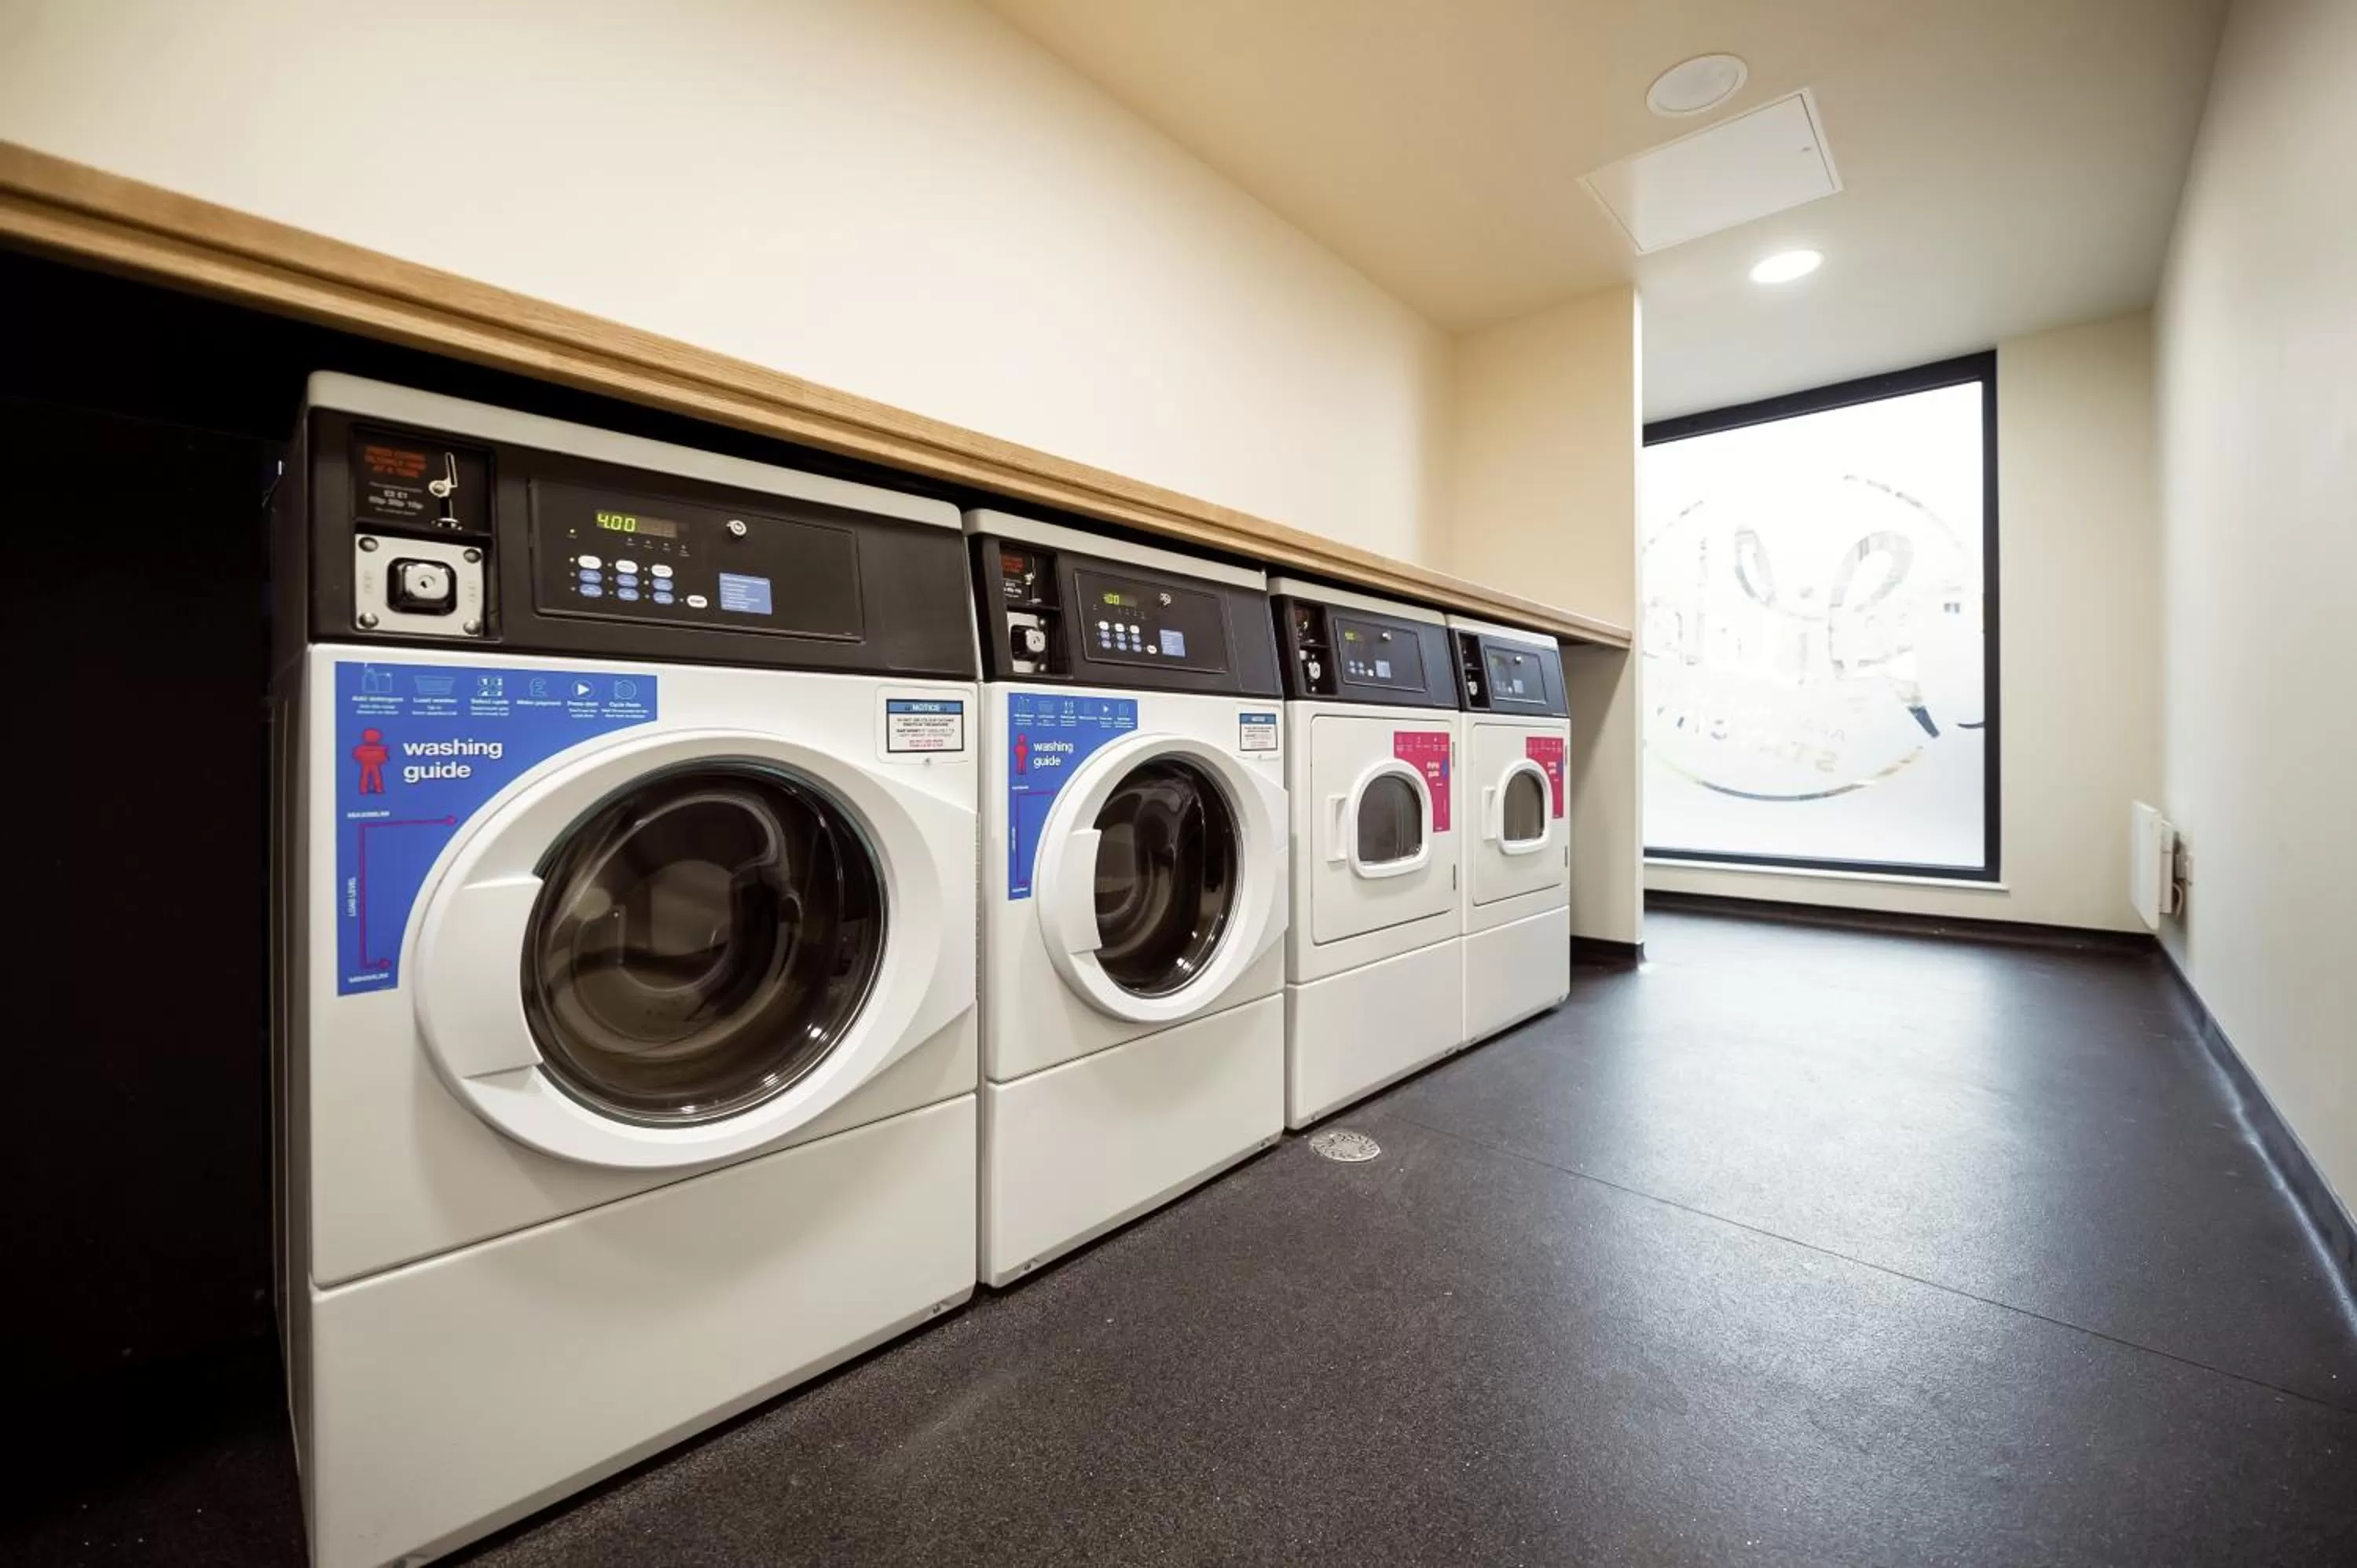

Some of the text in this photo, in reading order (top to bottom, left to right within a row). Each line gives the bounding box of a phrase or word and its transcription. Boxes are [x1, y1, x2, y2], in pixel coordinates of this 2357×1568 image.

[596, 512, 636, 533] 4.00
[403, 738, 504, 760] washing
[1033, 742, 1074, 754] washing
[403, 762, 472, 783] guide
[1033, 756, 1061, 769] guide
